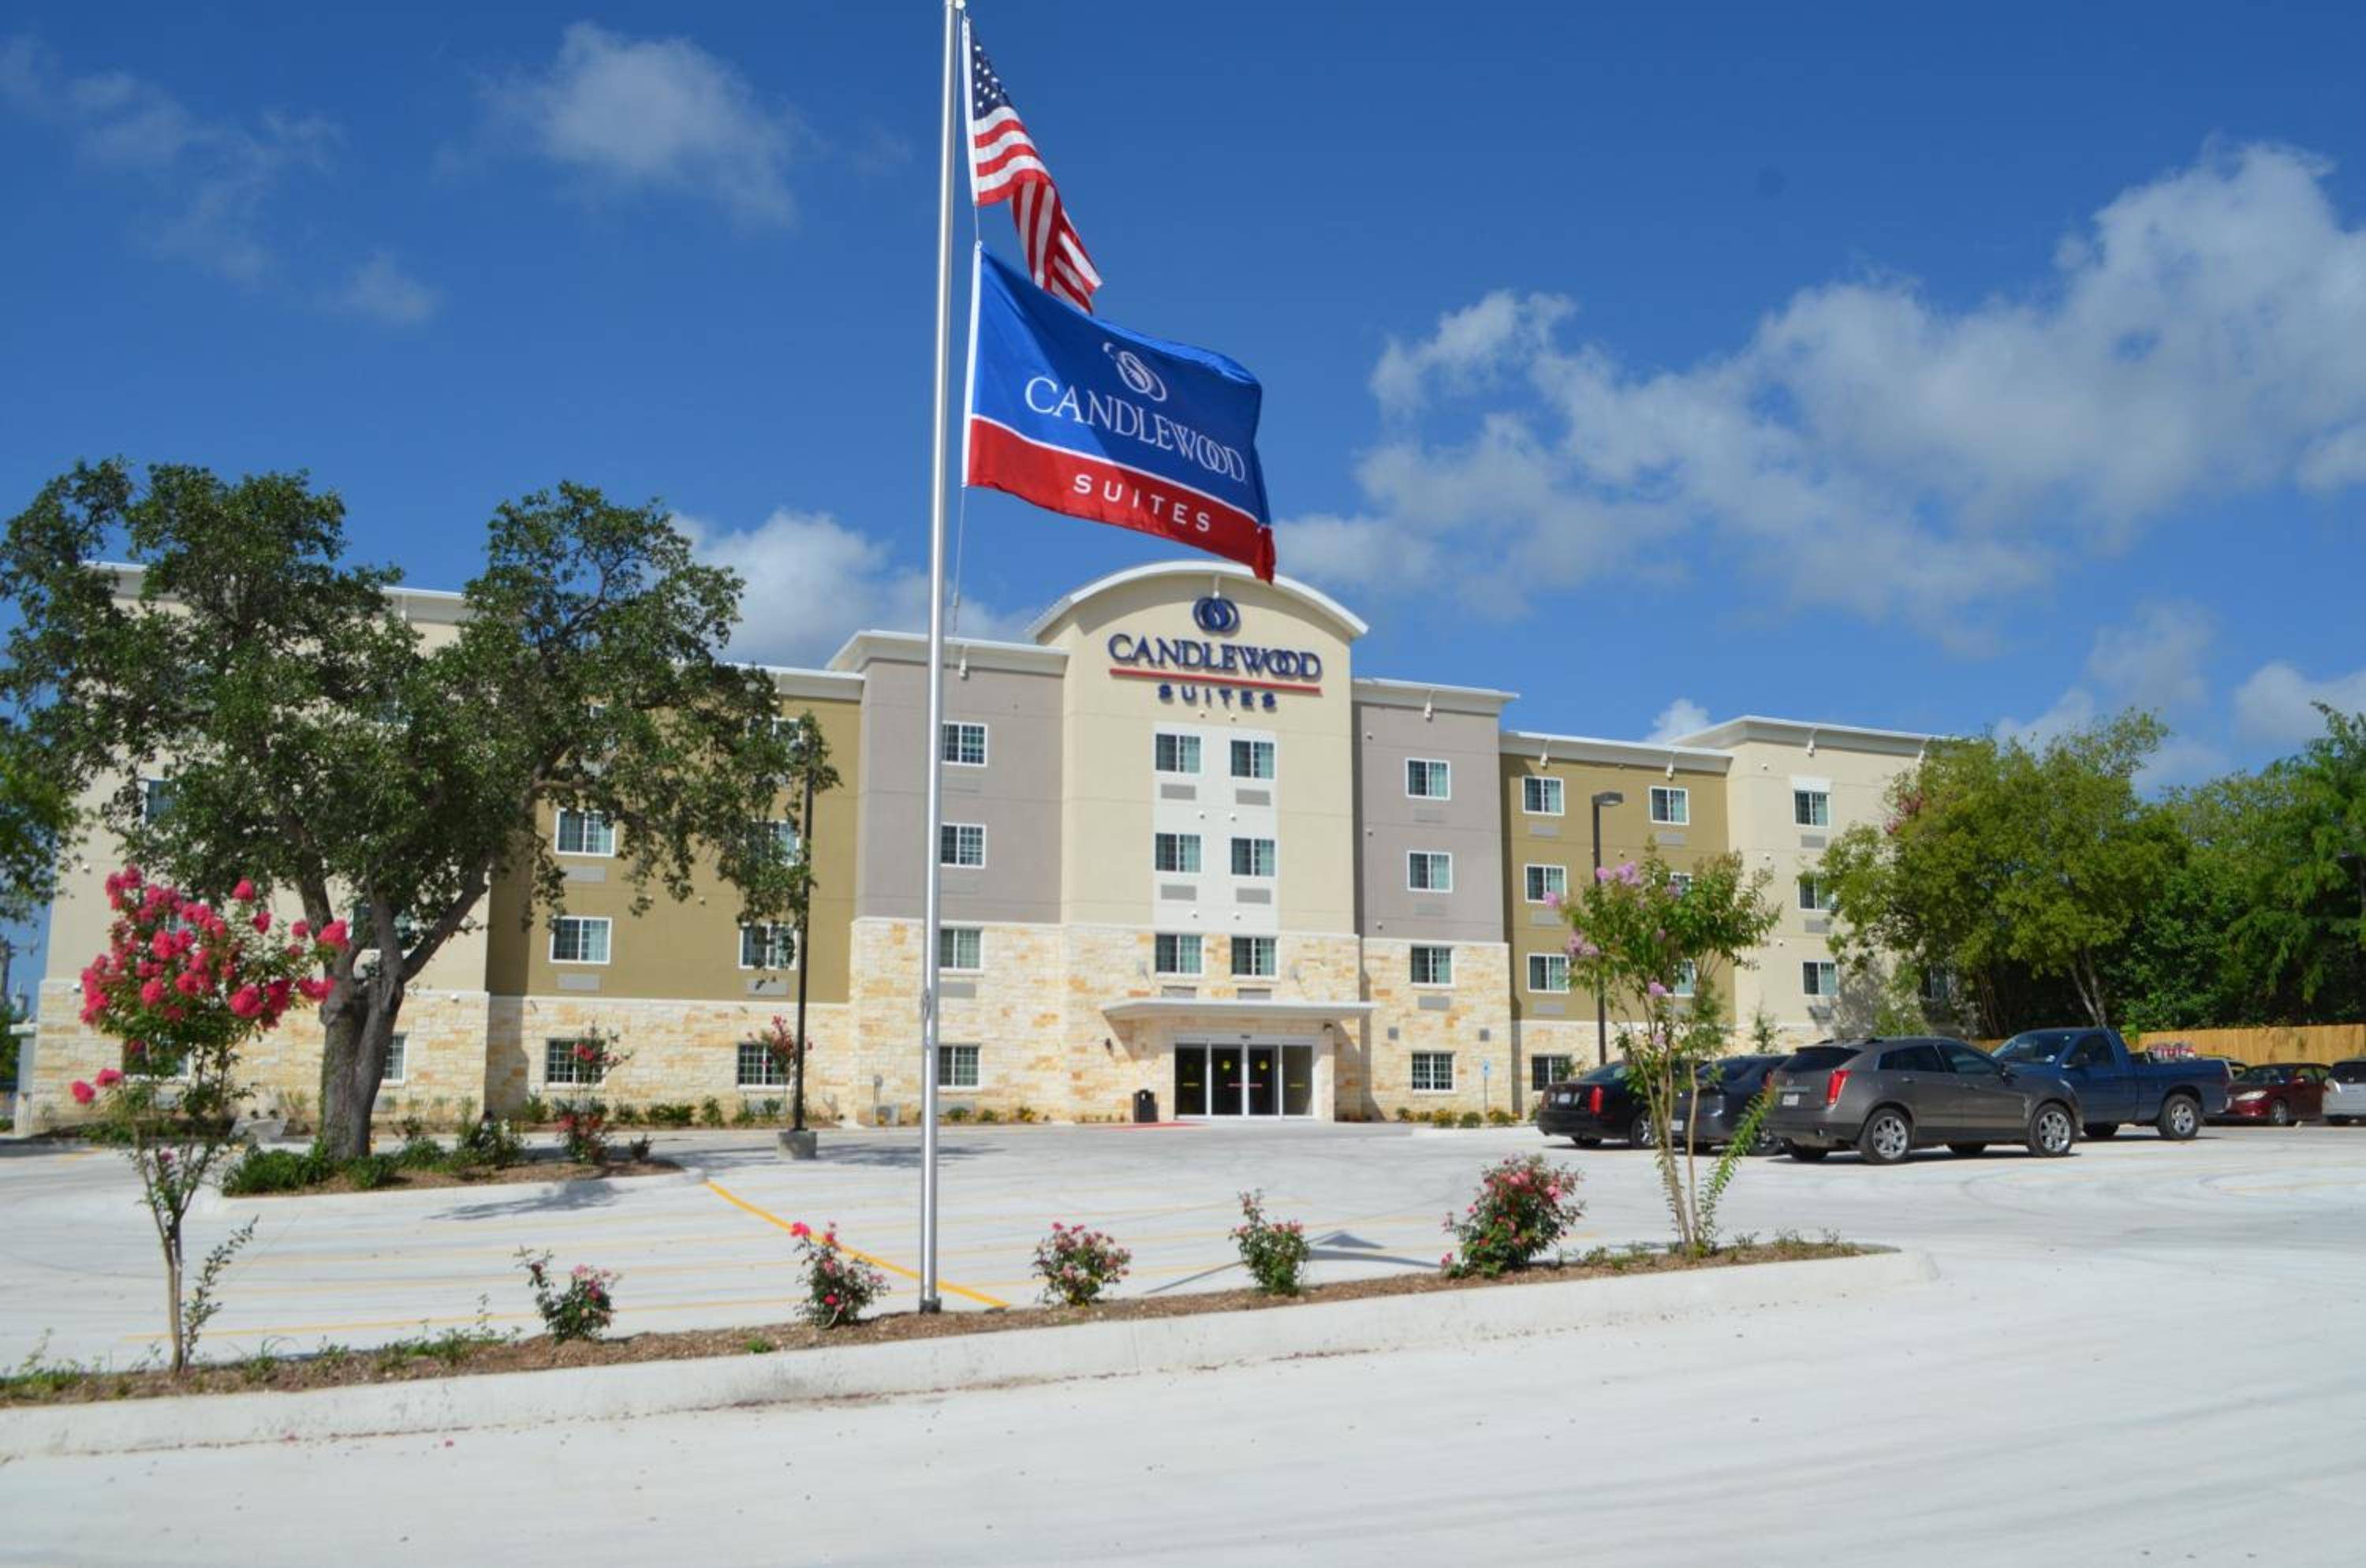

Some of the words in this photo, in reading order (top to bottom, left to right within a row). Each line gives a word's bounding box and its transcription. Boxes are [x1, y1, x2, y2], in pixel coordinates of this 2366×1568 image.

[1024, 375, 1246, 483] CANDLEWOOD
[1073, 473, 1211, 532] SUITES
[1108, 633, 1322, 680] CANDLEWOOD
[1159, 684, 1277, 709] SUITES
